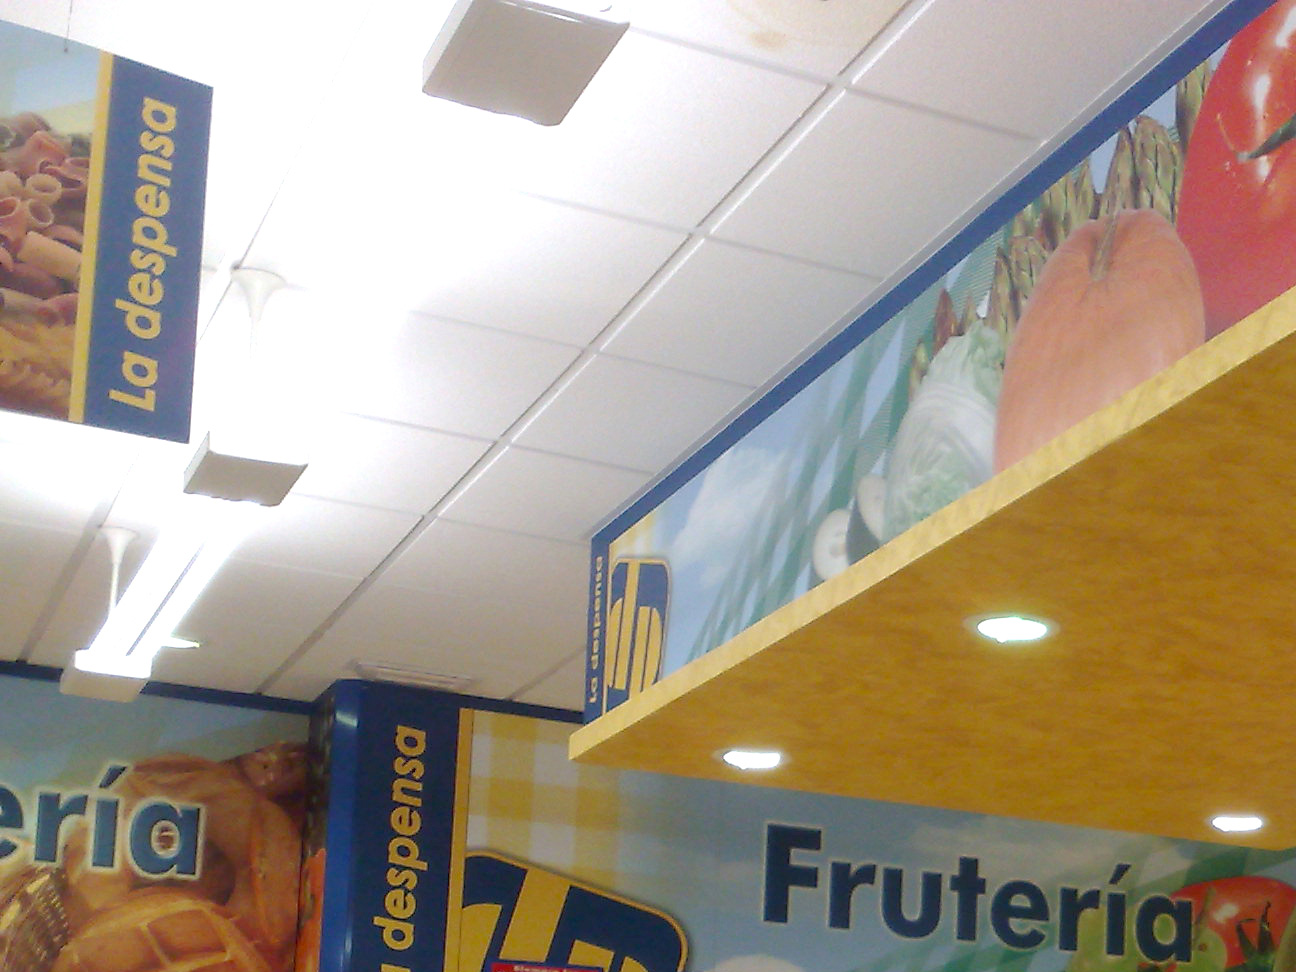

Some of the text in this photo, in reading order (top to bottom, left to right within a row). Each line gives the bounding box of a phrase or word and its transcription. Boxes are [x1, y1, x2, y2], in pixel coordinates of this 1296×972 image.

[108, 96, 178, 412] La despensa
[373, 724, 428, 951] despensa
[761, 821, 1195, 964] Frutería
